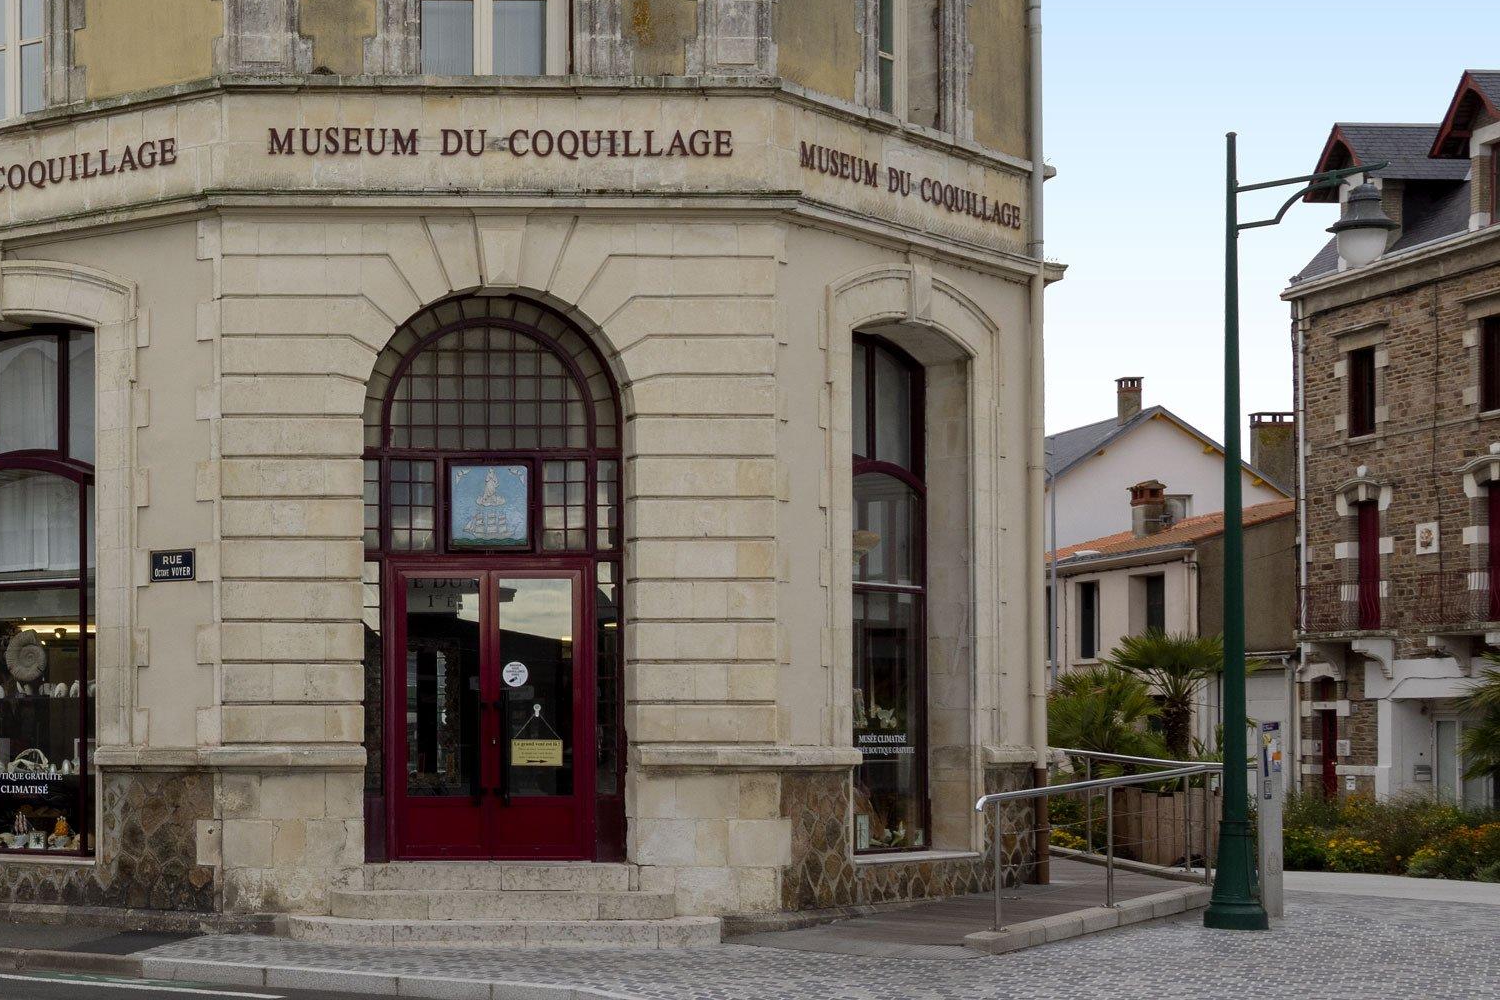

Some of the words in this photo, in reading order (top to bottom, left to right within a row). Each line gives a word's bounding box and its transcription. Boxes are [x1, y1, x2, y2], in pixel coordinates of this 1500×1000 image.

[267, 126, 419, 157] MUSEUM
[440, 128, 488, 157] DU
[508, 128, 735, 161] COQUILLAGE
[800, 140, 879, 188] MUSEUM
[888, 166, 912, 197] DU
[920, 177, 1021, 230] COQUILLAGE
[162, 555, 182, 565] RUE
[171, 566, 191, 576] VOYER
[859, 733, 877, 743] MUSÉE
[878, 733, 906, 743] CLIMATISÉ
[869, 746, 892, 755] BOUTIQUE
[25, 772, 63, 781] GRATUITE
[0, 784, 49, 794] CLIMATISÉ
